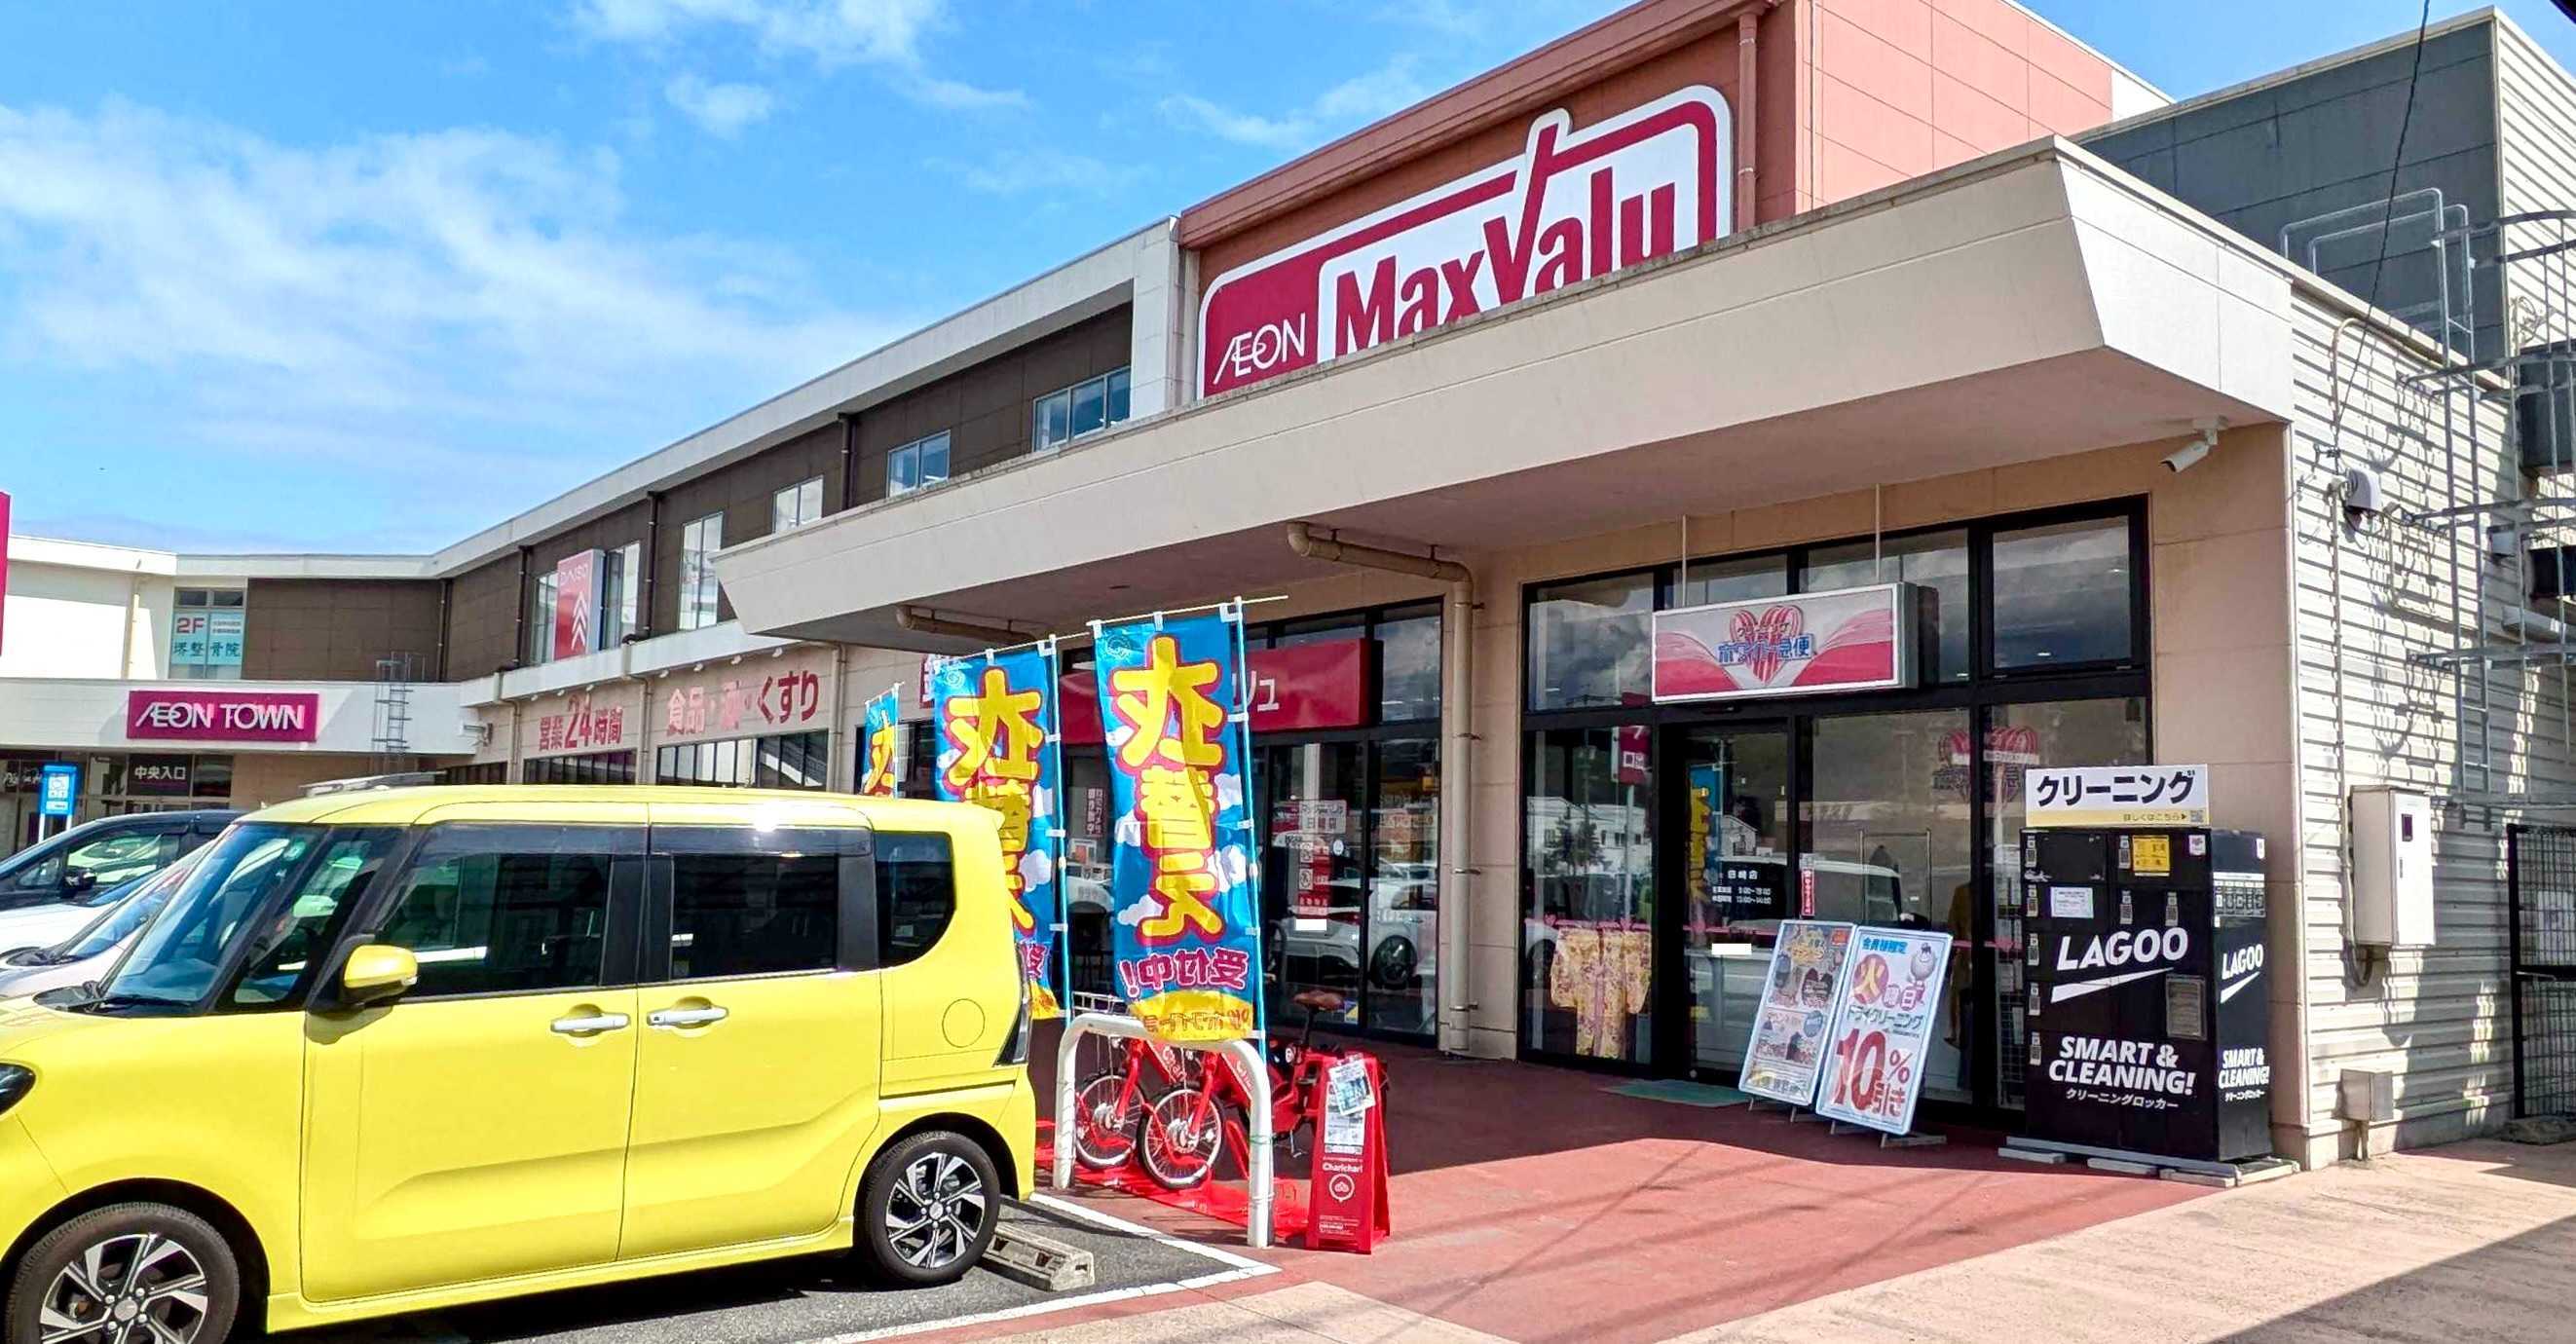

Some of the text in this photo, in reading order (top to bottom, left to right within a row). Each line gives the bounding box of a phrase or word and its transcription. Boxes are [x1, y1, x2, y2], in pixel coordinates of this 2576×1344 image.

[1335, 123, 1675, 356] MaxValu
[176, 616, 205, 634] 2F
[220, 702, 305, 730] TOWN
[134, 765, 186, 780] 中央入口
[2036, 769, 2195, 807] クリーニング
[2057, 927, 2188, 971] LAGOO
[2221, 944, 2264, 980] LAGOO
[2060, 1035, 2180, 1068] SMART &
[2222, 1047, 2264, 1069] SMART &
[2049, 1060, 2197, 1096] CLEANING!
[2218, 1066, 2270, 1089] CLEANING!
[2066, 1087, 2180, 1109] クリーニングロッカー
